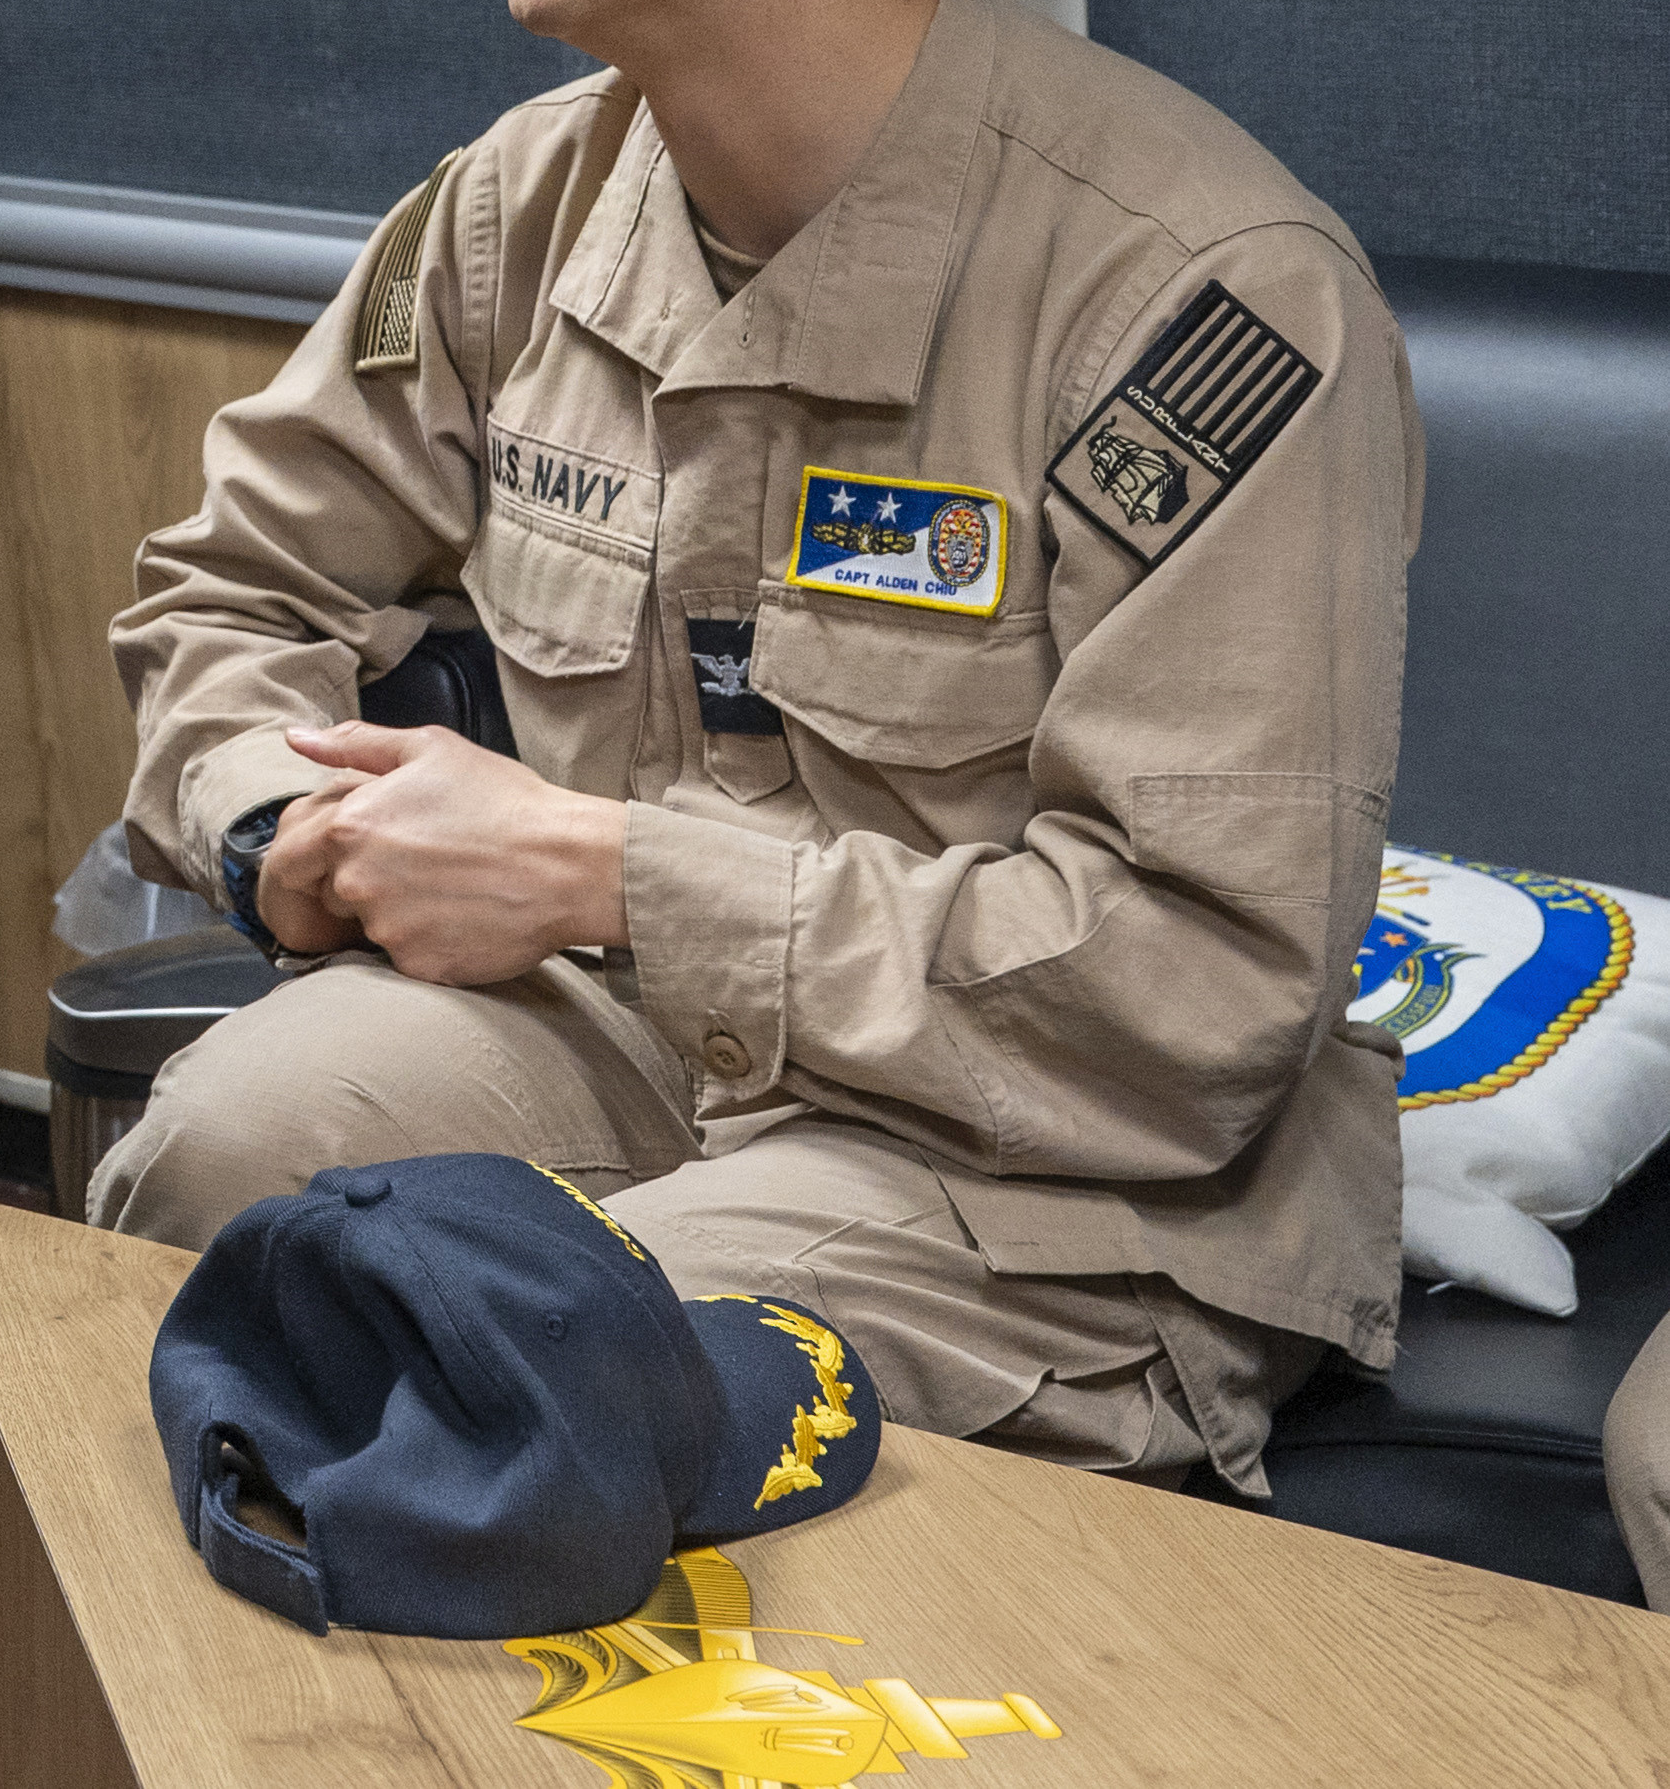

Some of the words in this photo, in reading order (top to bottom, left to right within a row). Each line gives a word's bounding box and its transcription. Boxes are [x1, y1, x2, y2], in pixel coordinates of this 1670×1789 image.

[1125, 384, 1232, 475] SURFLANT
[491, 436, 524, 493] U.S.
[531, 453, 627, 521] NAVY
[834, 568, 869, 587] CAPT
[875, 574, 918, 592] ALDEN
[924, 580, 958, 597] CHIU
